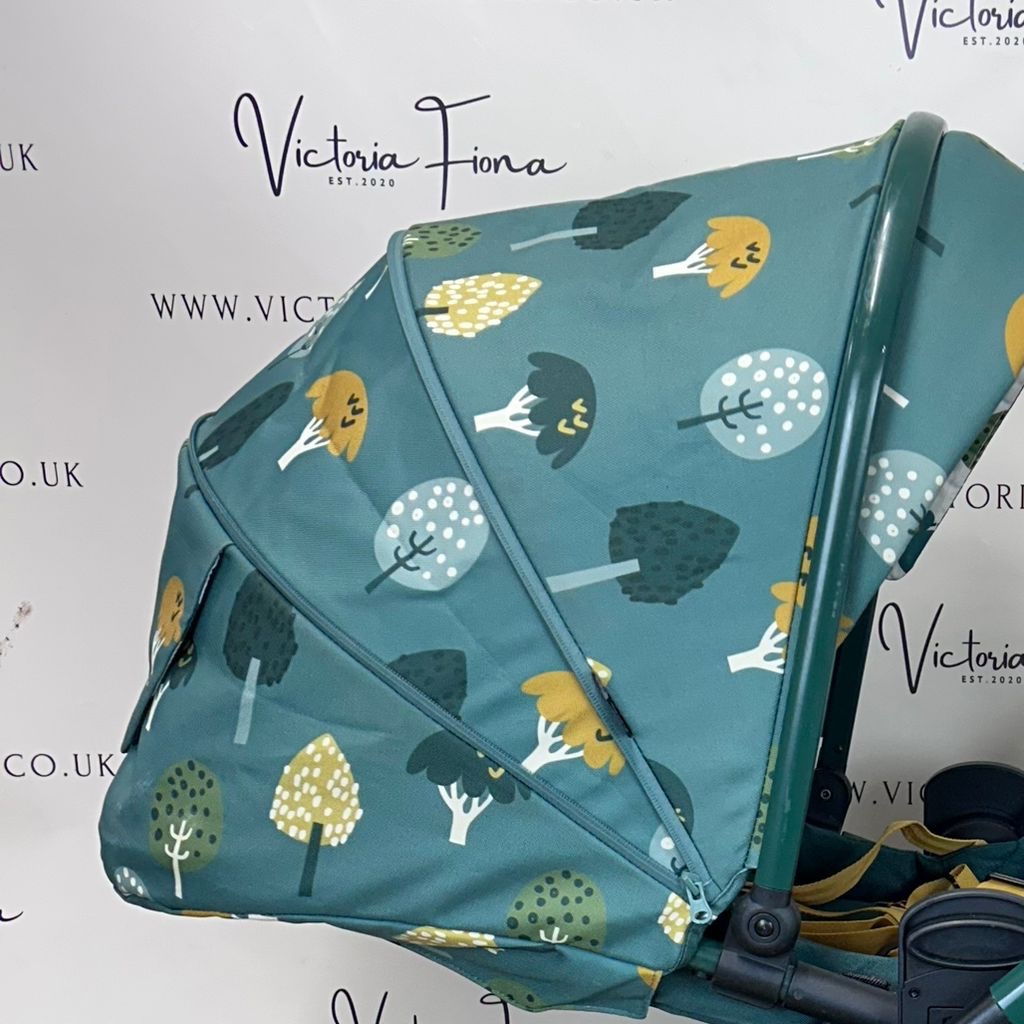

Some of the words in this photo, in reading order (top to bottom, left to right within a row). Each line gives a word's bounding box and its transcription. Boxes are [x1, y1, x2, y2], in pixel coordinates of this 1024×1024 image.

[233, 92, 420, 197] Victoria
[414, 95, 567, 210] Fiona
[328, 176, 396, 188] EST.2020
[961, 675, 1023, 684] EST.2020
